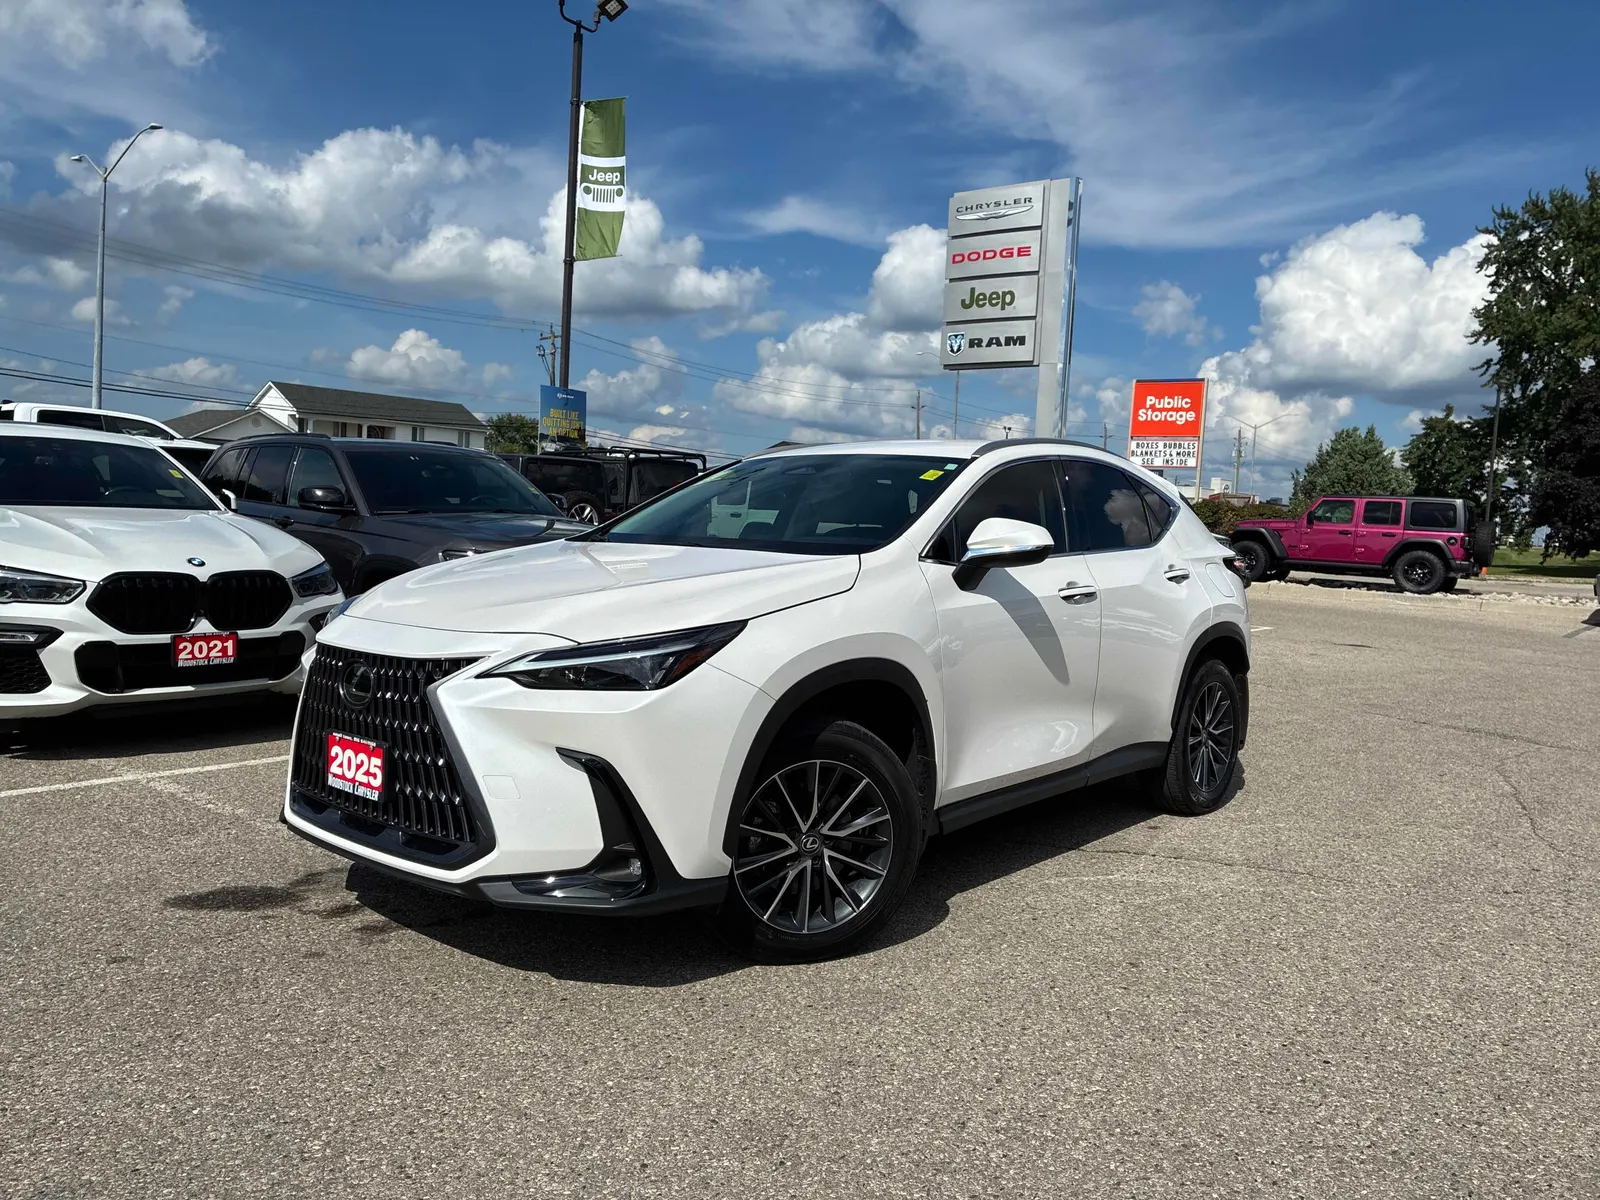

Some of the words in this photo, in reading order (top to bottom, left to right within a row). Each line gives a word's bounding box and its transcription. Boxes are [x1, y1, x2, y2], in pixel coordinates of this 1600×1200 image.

[588, 169, 621, 184] Jeep
[955, 196, 1033, 213] CHRYSLER
[951, 246, 1032, 265] DODGE
[960, 287, 1016, 311] Jeep
[968, 335, 1026, 349] RAM
[1145, 395, 1191, 408] Public
[1138, 408, 1196, 425] Storage
[1163, 442, 1196, 450] BUBBLES
[1162, 458, 1188, 466] INSIDE
[178, 639, 233, 659] 2021
[329, 745, 383, 788] 2025
